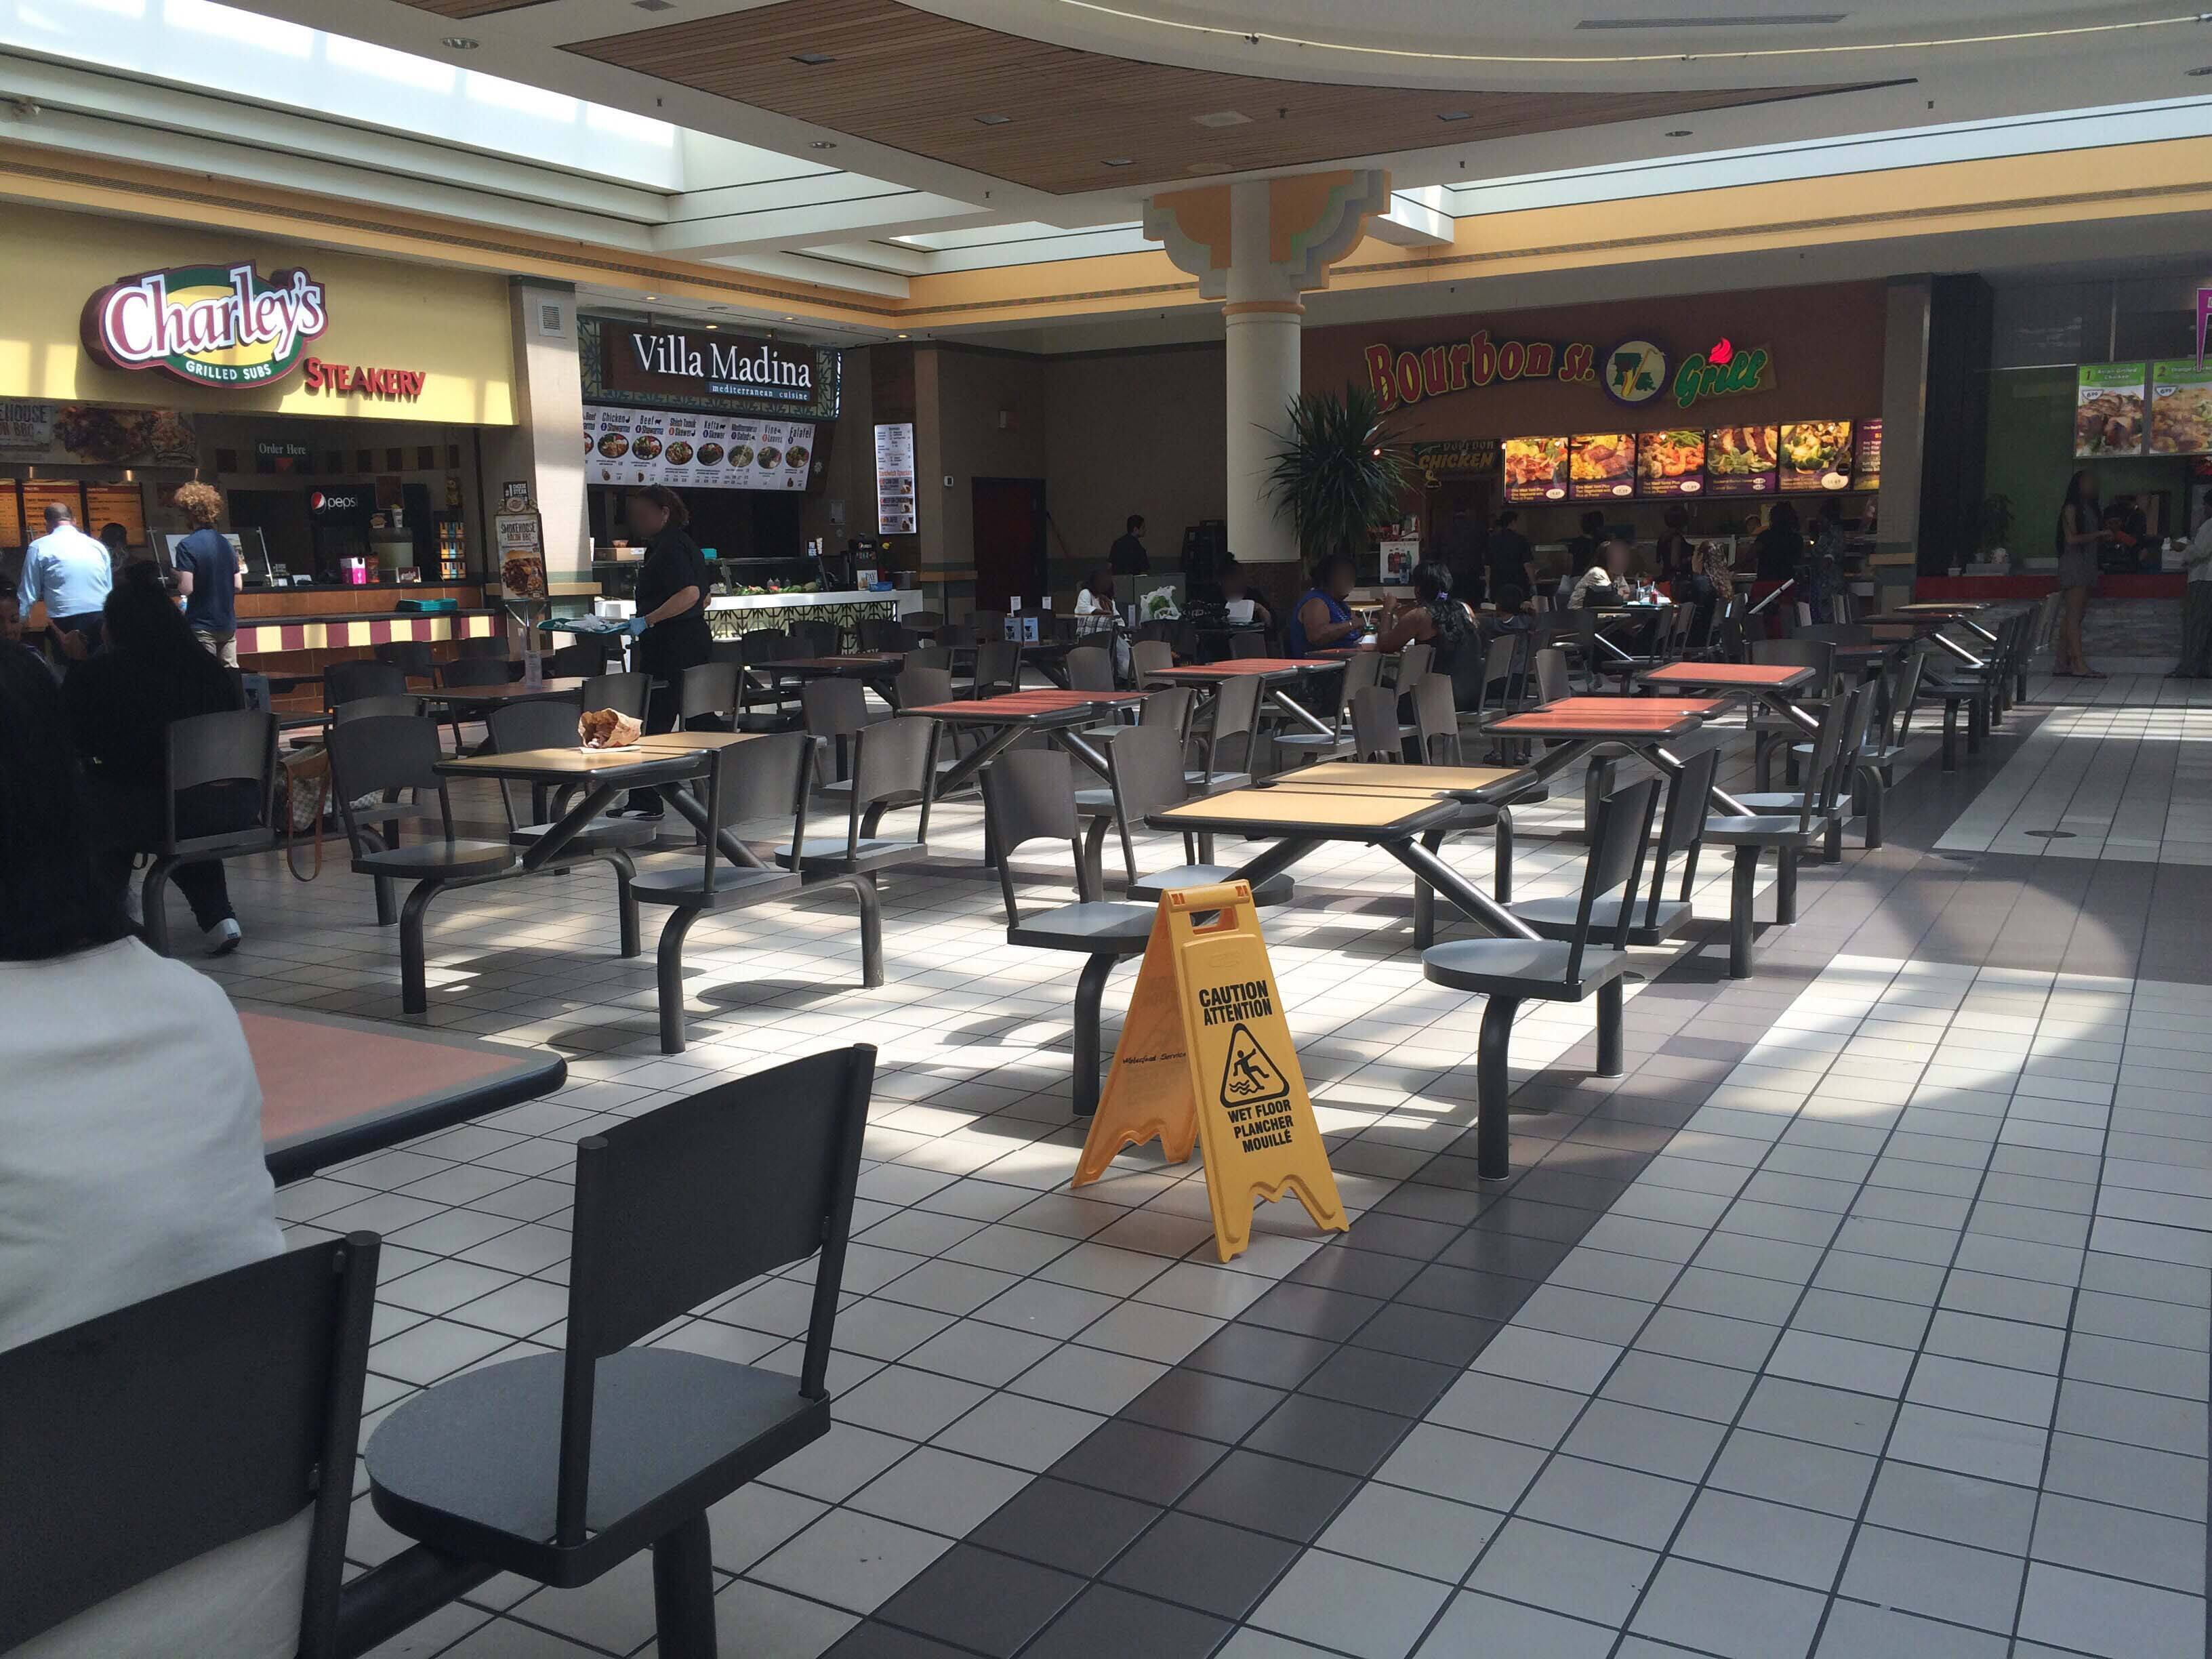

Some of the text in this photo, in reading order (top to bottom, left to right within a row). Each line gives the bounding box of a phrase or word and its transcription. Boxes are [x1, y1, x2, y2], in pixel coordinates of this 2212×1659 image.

[105, 265, 324, 361] Charley's
[633, 333, 812, 388] Villa Madina
[186, 361, 272, 380] GRILLED SUBS
[305, 356, 426, 396] STEAKERY
[1365, 329, 1595, 415] Bourbon St.
[1673, 348, 1767, 409] Grill
[2157, 365, 2167, 377] 2
[712, 384, 808, 401] mediterranean cuisine
[602, 412, 626, 424] Chicken
[640, 415, 655, 425] Beef
[764, 424, 777, 434] Vine
[790, 426, 812, 438] Falafel
[768, 435, 783, 443] Leaves
[259, 443, 306, 455] Order Here
[1418, 452, 1494, 469] CHICKEN
[501, 523, 536, 534] SMOKEHOUSE
[1198, 979, 1269, 1008] CAUTION
[1204, 998, 1273, 1026] ATTENTION
[1227, 1099, 1292, 1124] WET FLOOR
[1234, 1115, 1294, 1139] PLANCHER
[1242, 1130, 1293, 1153] MOUILLÉ
